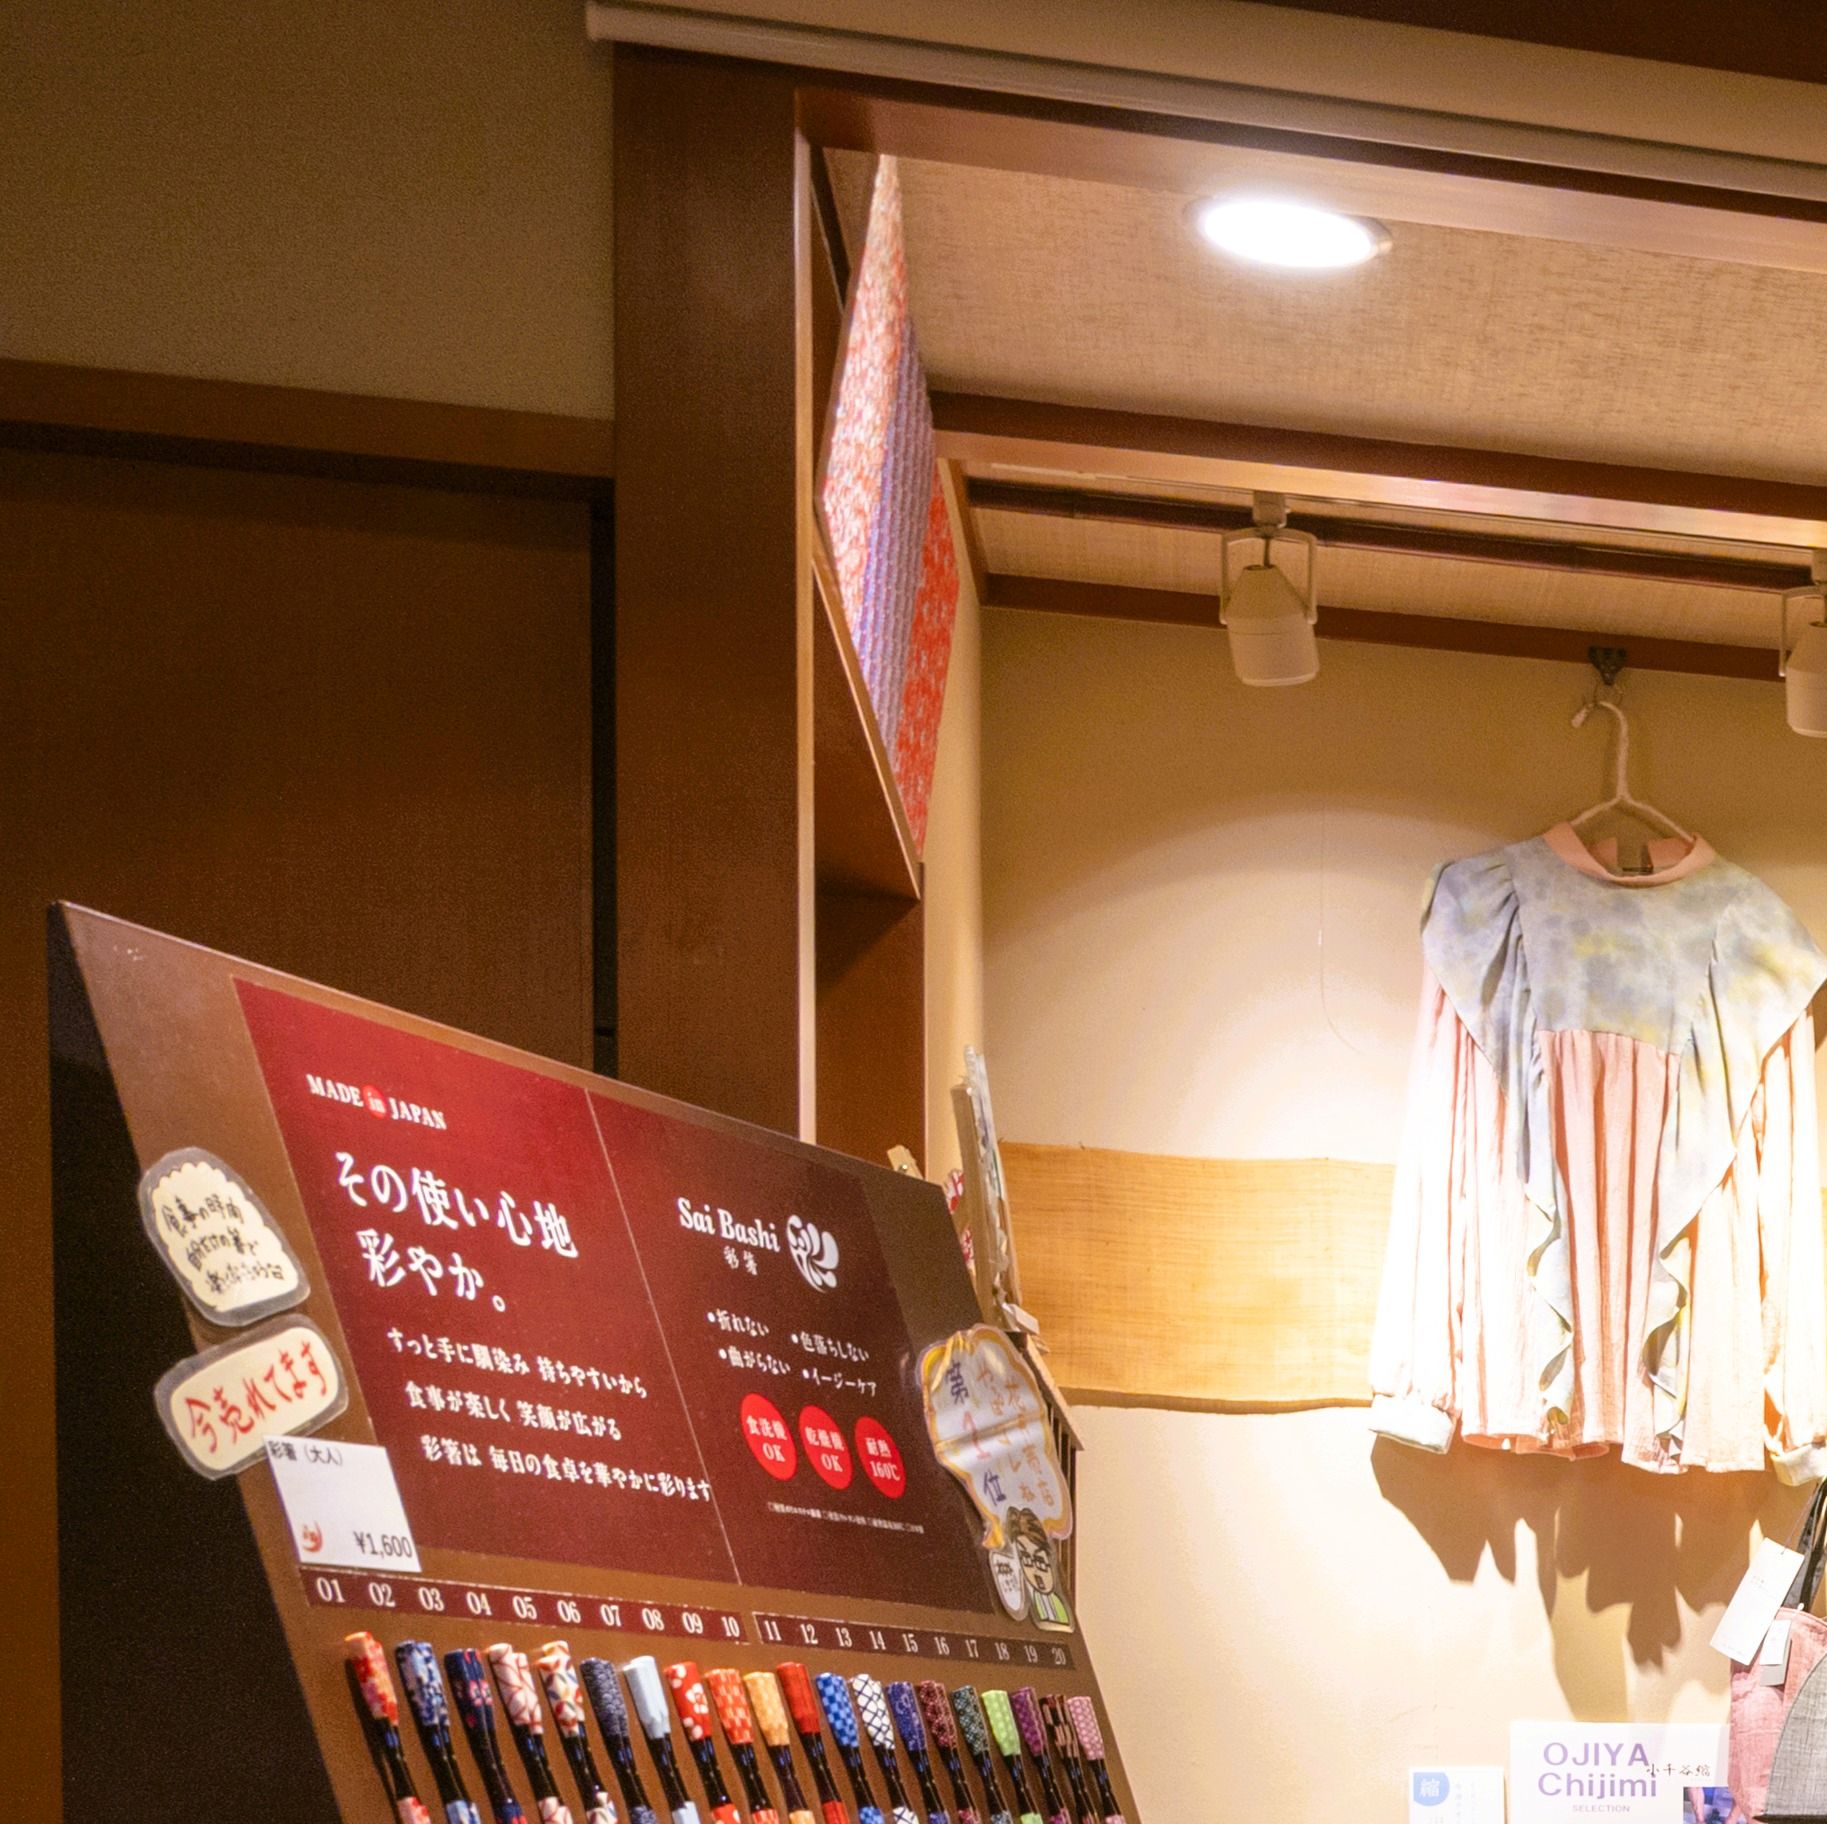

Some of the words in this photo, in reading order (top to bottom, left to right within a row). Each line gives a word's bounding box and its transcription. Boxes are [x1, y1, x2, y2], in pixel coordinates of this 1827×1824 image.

[306, 1074, 364, 1107] MADE
[366, 1092, 386, 1113] in
[388, 1097, 447, 1130] JAPAN
[336, 1152, 579, 1258] その使い心地
[677, 1197, 716, 1235] Sai
[717, 1208, 780, 1252] Bashi
[356, 1228, 506, 1312] 彩やか。
[723, 1246, 758, 1275] 彩箸
[717, 1308, 769, 1336] 折れない
[728, 1346, 791, 1375] 曲がらない
[801, 1331, 869, 1362] 色落ちしない
[388, 1327, 530, 1375] すっと手に馴染み
[537, 1356, 647, 1398] 持ちやすいから
[812, 1368, 877, 1397] イージーケア
[184, 1341, 329, 1454] 今売れてます
[405, 1381, 511, 1422] 食事が楽しく
[517, 1400, 621, 1440] 笑顔が広がる
[746, 1415, 787, 1441] 食洗機
[804, 1427, 845, 1451] 乾燥機
[762, 1443, 786, 1463] OK
[864, 1437, 892, 1458] 耐熱
[421, 1434, 482, 1466] 彩箸は
[488, 1445, 712, 1501] 毎日の食卓を華やかに彩ります
[821, 1453, 843, 1472] OK
[354, 1531, 412, 1558] ¥1,600
[316, 1577, 345, 1603] 01
[369, 1582, 395, 1608] 02
[418, 1587, 444, 1612] 03
[466, 1591, 492, 1615] 04
[512, 1595, 537, 1620] 05
[557, 1600, 581, 1624] 06
[600, 1604, 622, 1628] 07
[641, 1607, 664, 1631] 08
[683, 1612, 703, 1636] 09
[721, 1616, 740, 1637] 10
[764, 1619, 781, 1641] 11
[801, 1623, 818, 1645] 12
[835, 1627, 852, 1648] 13
[869, 1630, 886, 1650] 14
[902, 1633, 918, 1653] 15
[934, 1636, 950, 1656] 16
[965, 1639, 980, 1658] 17
[995, 1641, 1010, 1661] 18
[1024, 1645, 1038, 1663] 19
[1052, 1647, 1067, 1665] 20
[1543, 1742, 1650, 1766] OJIYA
[1420, 1778, 1440, 1798] 縮
[1538, 1772, 1657, 1800] Chijimi
[1573, 1804, 1631, 1813] SELECTION
